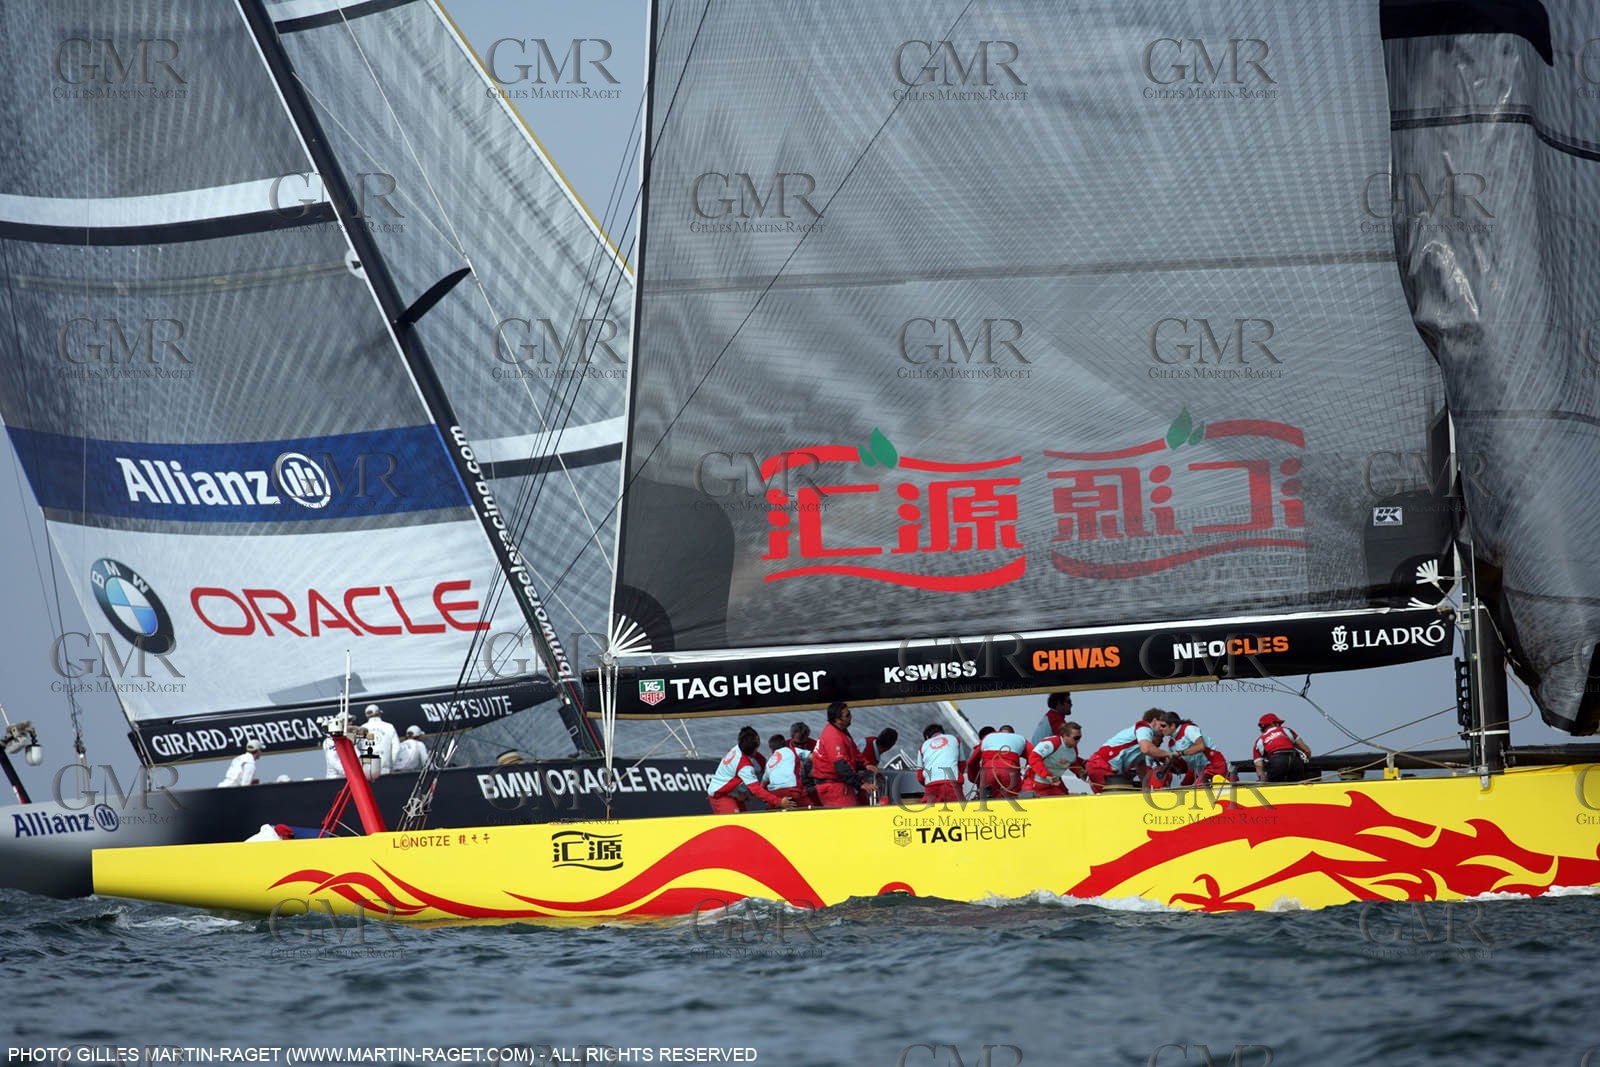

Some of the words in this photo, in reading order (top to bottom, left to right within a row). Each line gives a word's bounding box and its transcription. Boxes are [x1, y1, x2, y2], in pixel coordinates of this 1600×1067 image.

[116, 457, 280, 505] Allianz
[761, 478, 1024, 560] 汇源
[92, 560, 149, 594] BMW
[190, 580, 490, 637] ORACLE
[1173, 636, 1289, 660] NEOCLES
[1352, 619, 1446, 648] LLADRÓ
[1033, 646, 1120, 672] CHIVAS
[477, 771, 542, 799] BMW
[546, 767, 646, 796] ORACLE
[12, 812, 94, 838] Allianz
